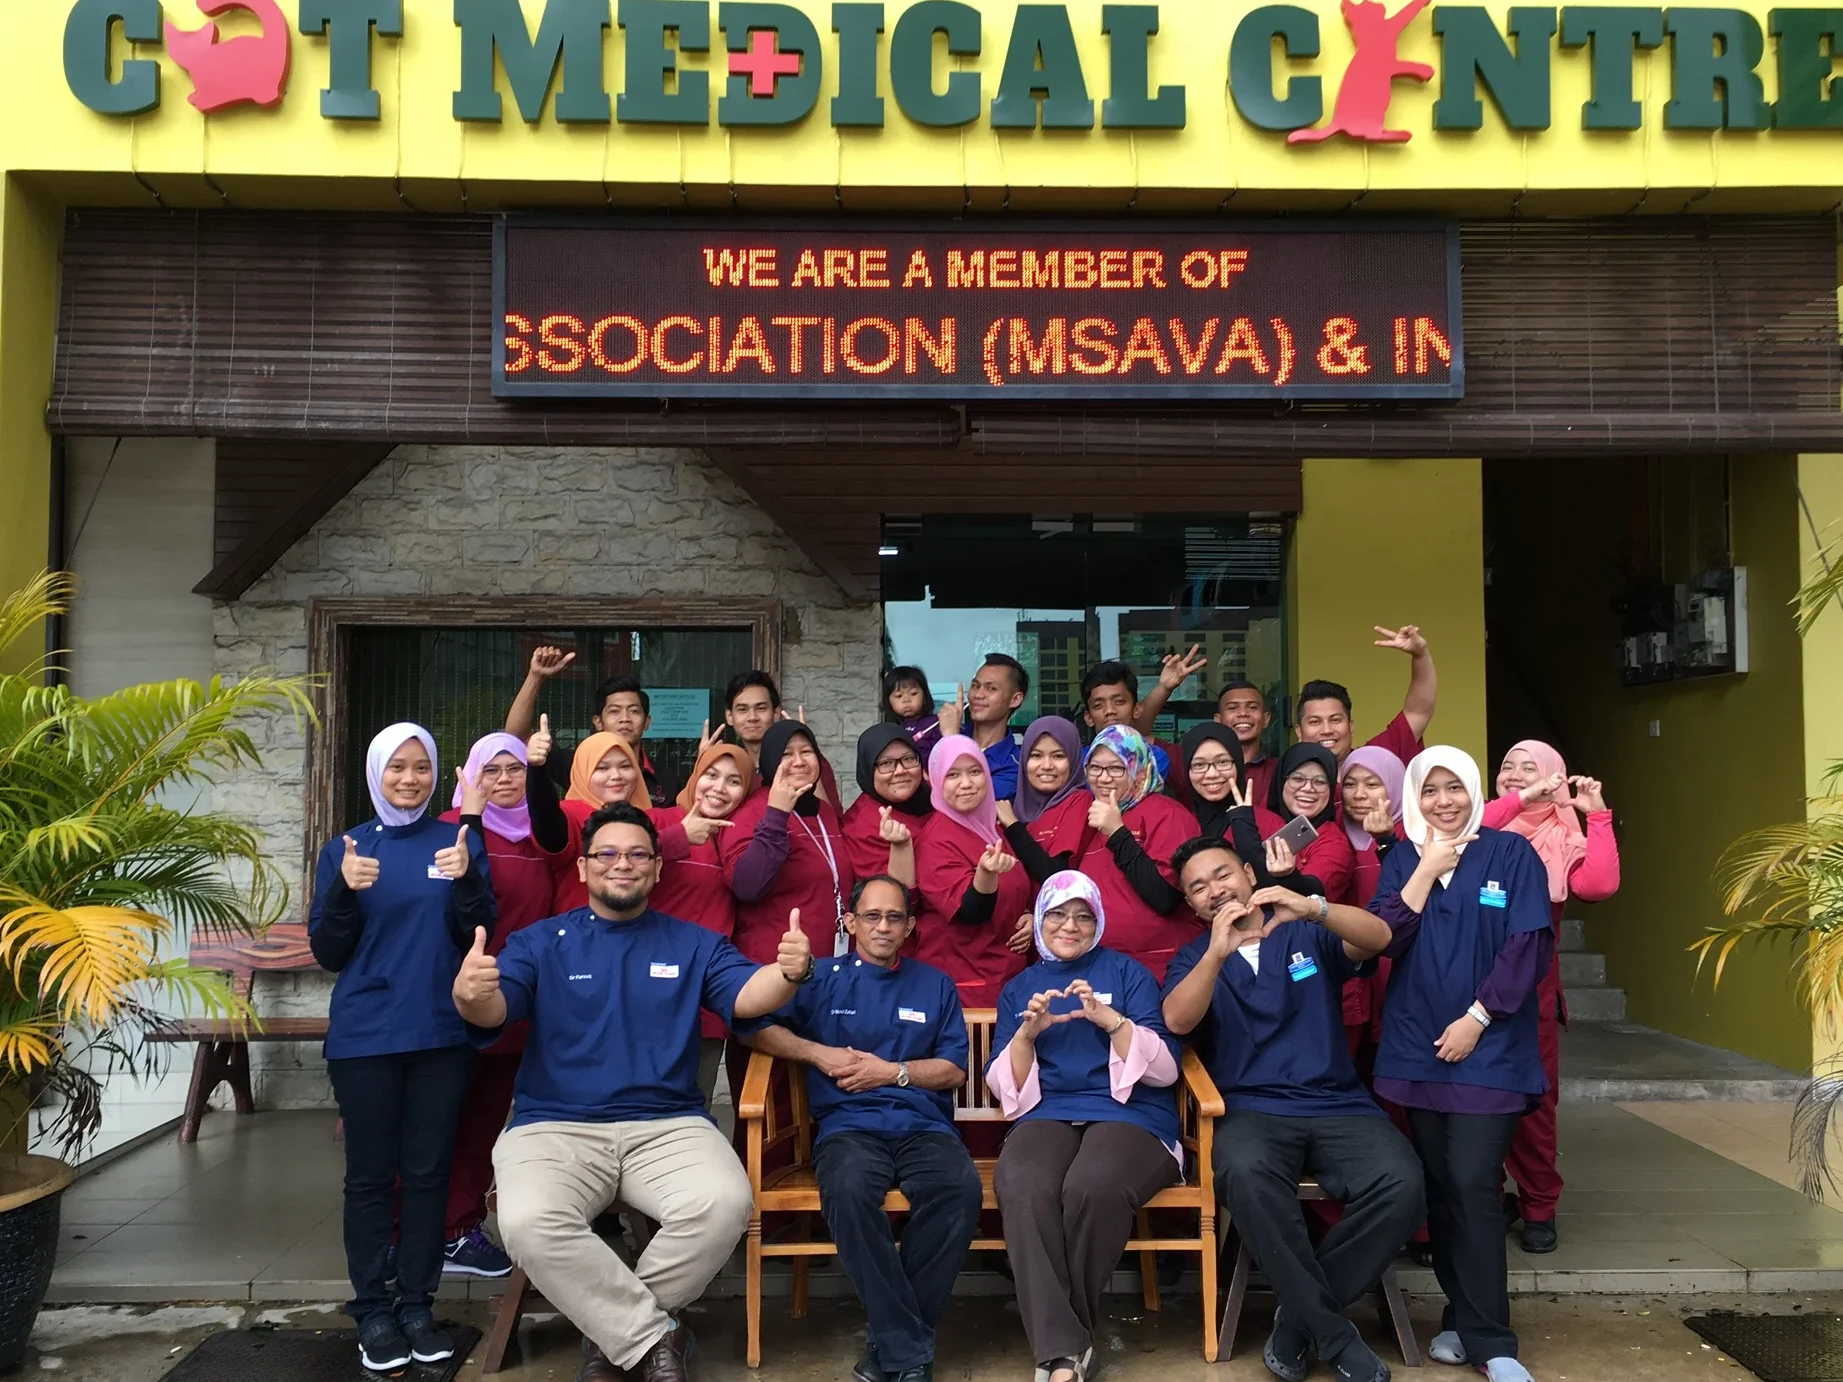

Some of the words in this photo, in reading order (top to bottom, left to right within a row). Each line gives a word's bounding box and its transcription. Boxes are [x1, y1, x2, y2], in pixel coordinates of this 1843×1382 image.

[452, 0, 1186, 127] MEDICAL
[702, 248, 779, 287] WE
[791, 248, 890, 287] ARE
[902, 249, 932, 287] A
[946, 249, 1166, 288] MEMBER
[1180, 250, 1248, 288] OF
[983, 317, 1296, 386] (MSAVA)
[1316, 317, 1371, 373] &
